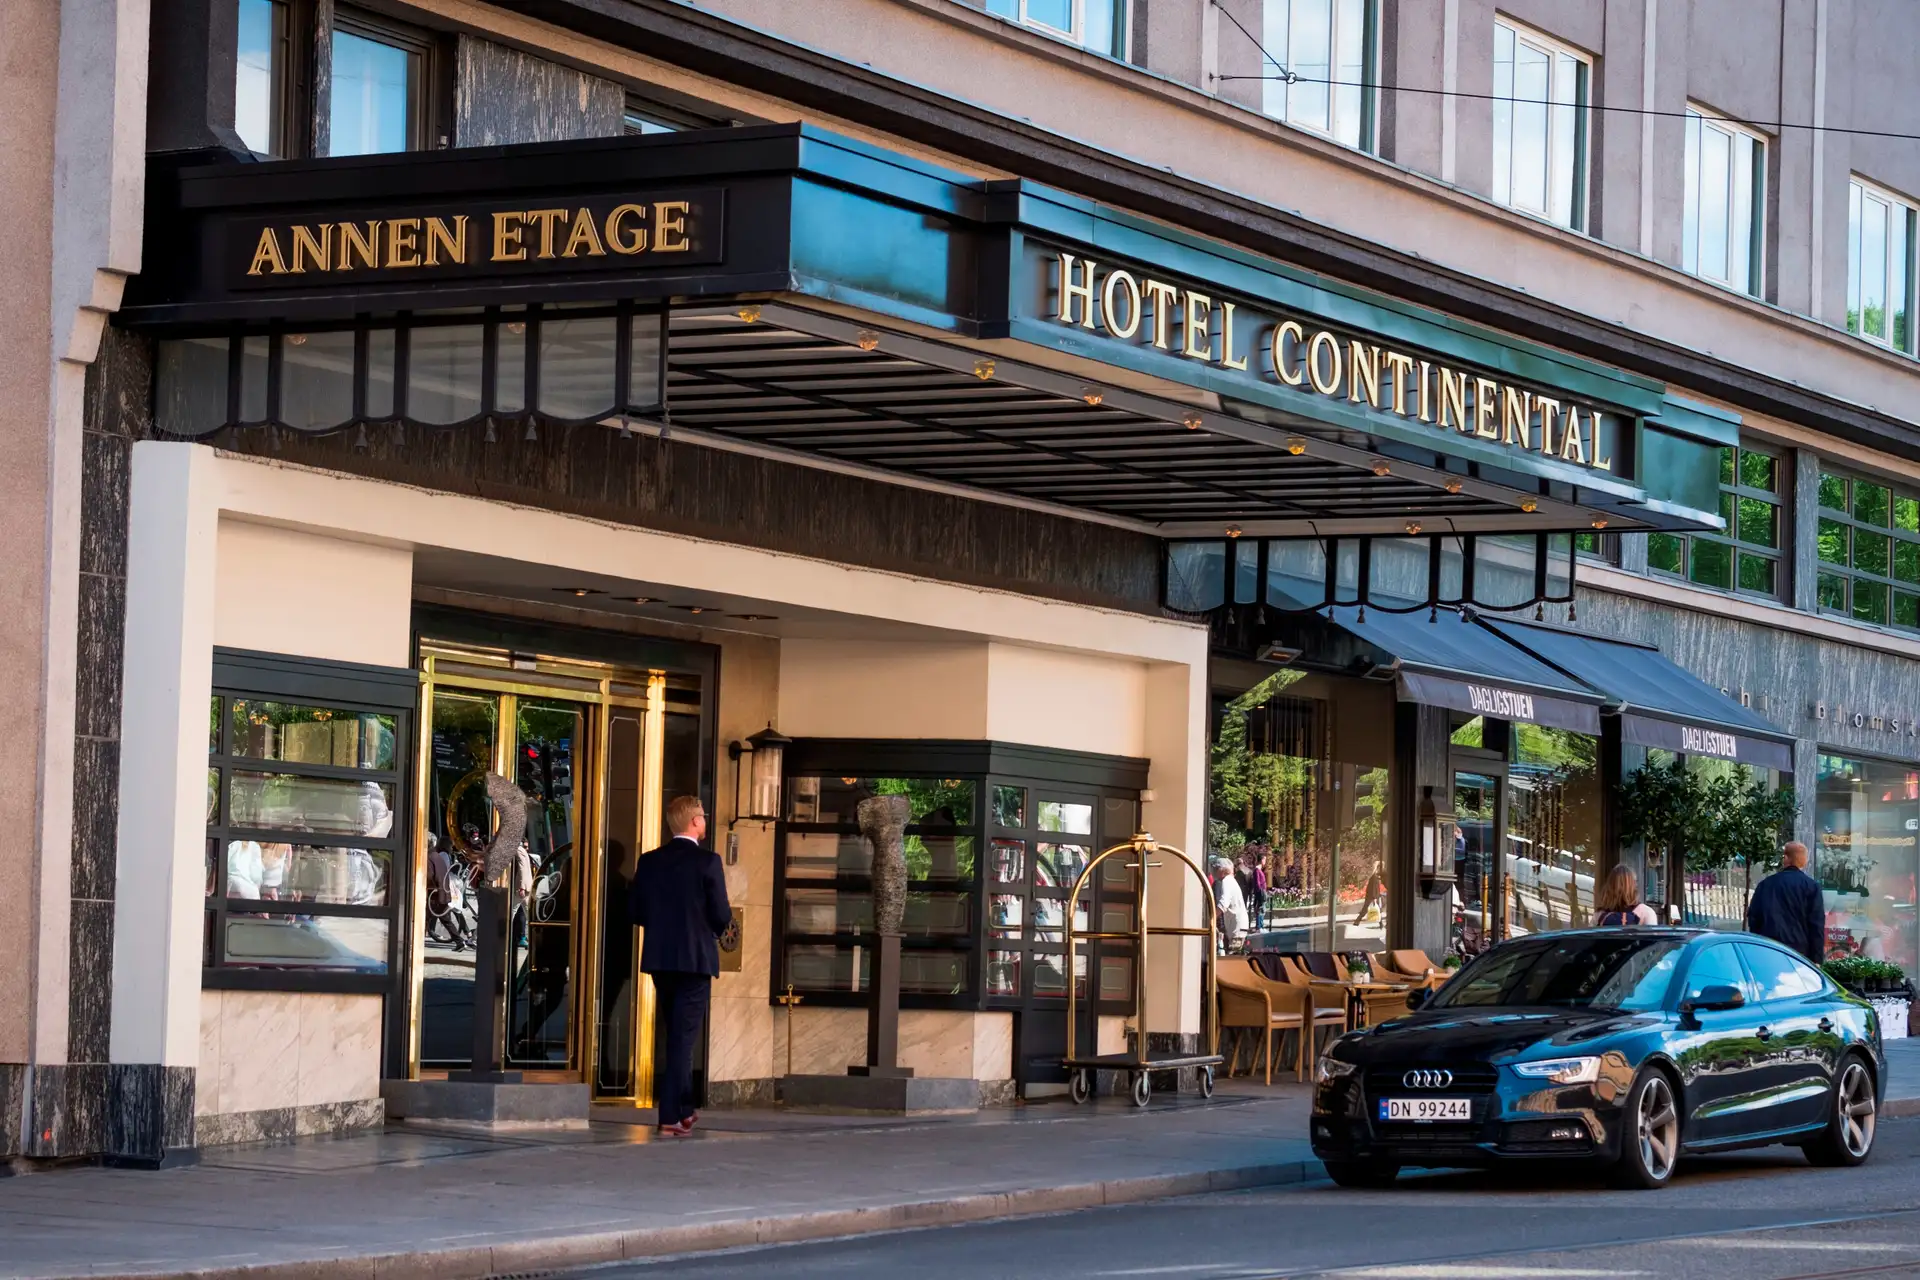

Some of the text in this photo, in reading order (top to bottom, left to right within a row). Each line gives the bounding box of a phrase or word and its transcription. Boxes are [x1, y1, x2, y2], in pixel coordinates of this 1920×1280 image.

[246, 201, 689, 275] ANNEN ETAGE
[1057, 253, 1611, 471] HOTEL CONTINENTAL
[1468, 686, 1535, 719] DAGLIGSTUEN
[1682, 727, 1737, 757] DAGLIGSTUEN
[1390, 1102, 1468, 1117] DN 99244
